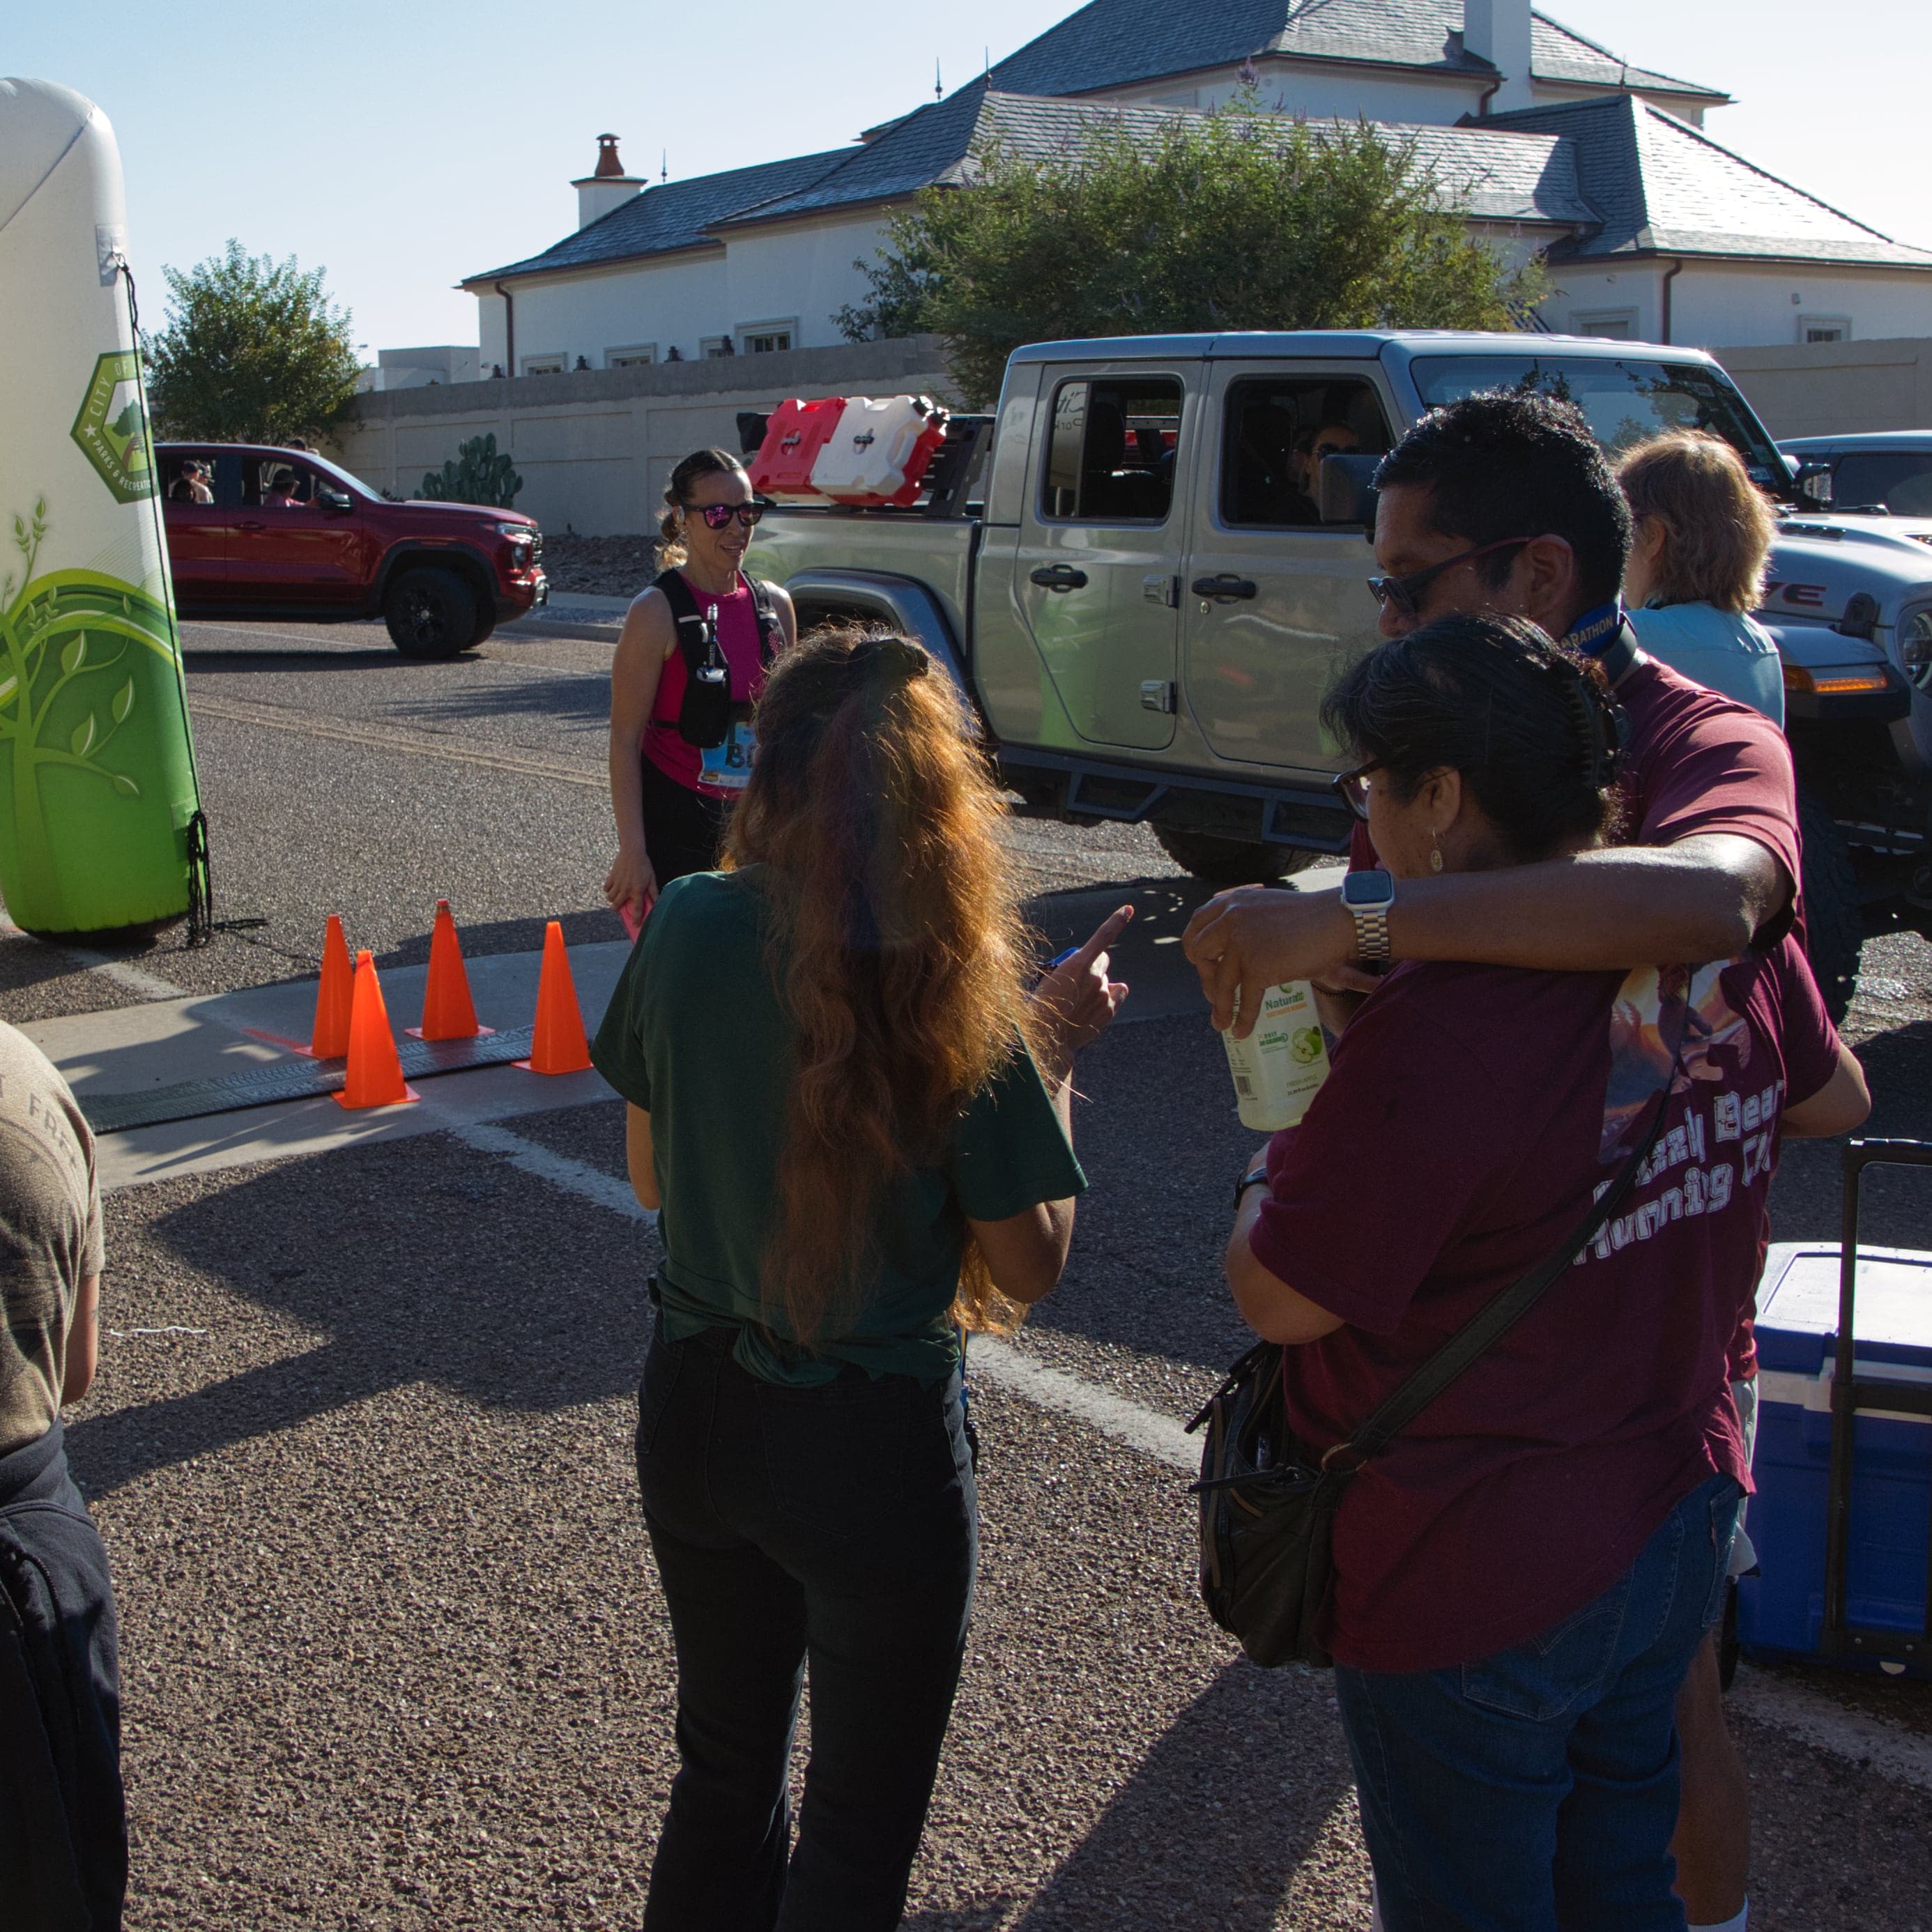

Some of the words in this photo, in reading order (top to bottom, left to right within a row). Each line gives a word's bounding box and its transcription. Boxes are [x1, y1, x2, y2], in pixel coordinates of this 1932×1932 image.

[90, 376, 112, 417] CITY
[114, 360, 128, 376] OF
[93, 439, 114, 469] PARKS
[1561, 615, 1613, 649] ARATHON
